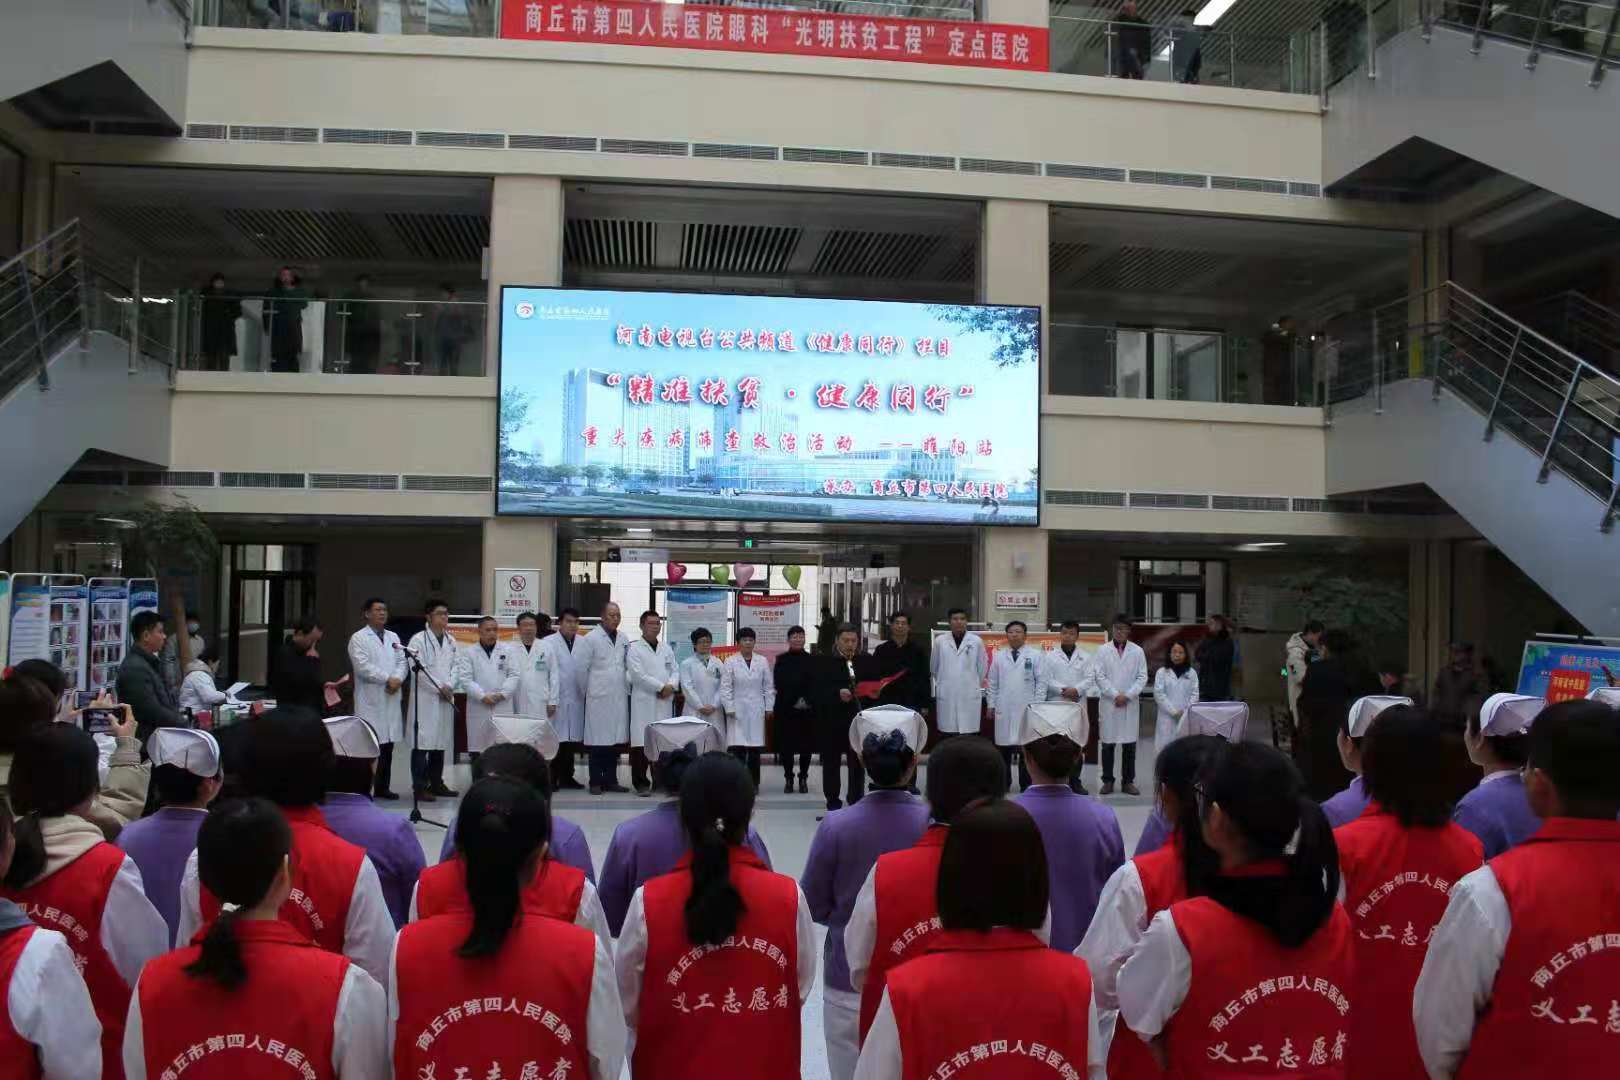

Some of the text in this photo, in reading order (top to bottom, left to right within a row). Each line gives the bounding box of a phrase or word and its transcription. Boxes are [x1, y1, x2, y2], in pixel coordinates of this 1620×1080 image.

[672, 983, 790, 1014] 义工志愿者
[1208, 975, 1350, 1033] 商丘市第四人民医院
[415, 997, 573, 1052] 商丘市第四人民医院
[927, 1039, 1081, 1080] 丘市第四人民医院
[1206, 1030, 1347, 1069] 义工志愿者
